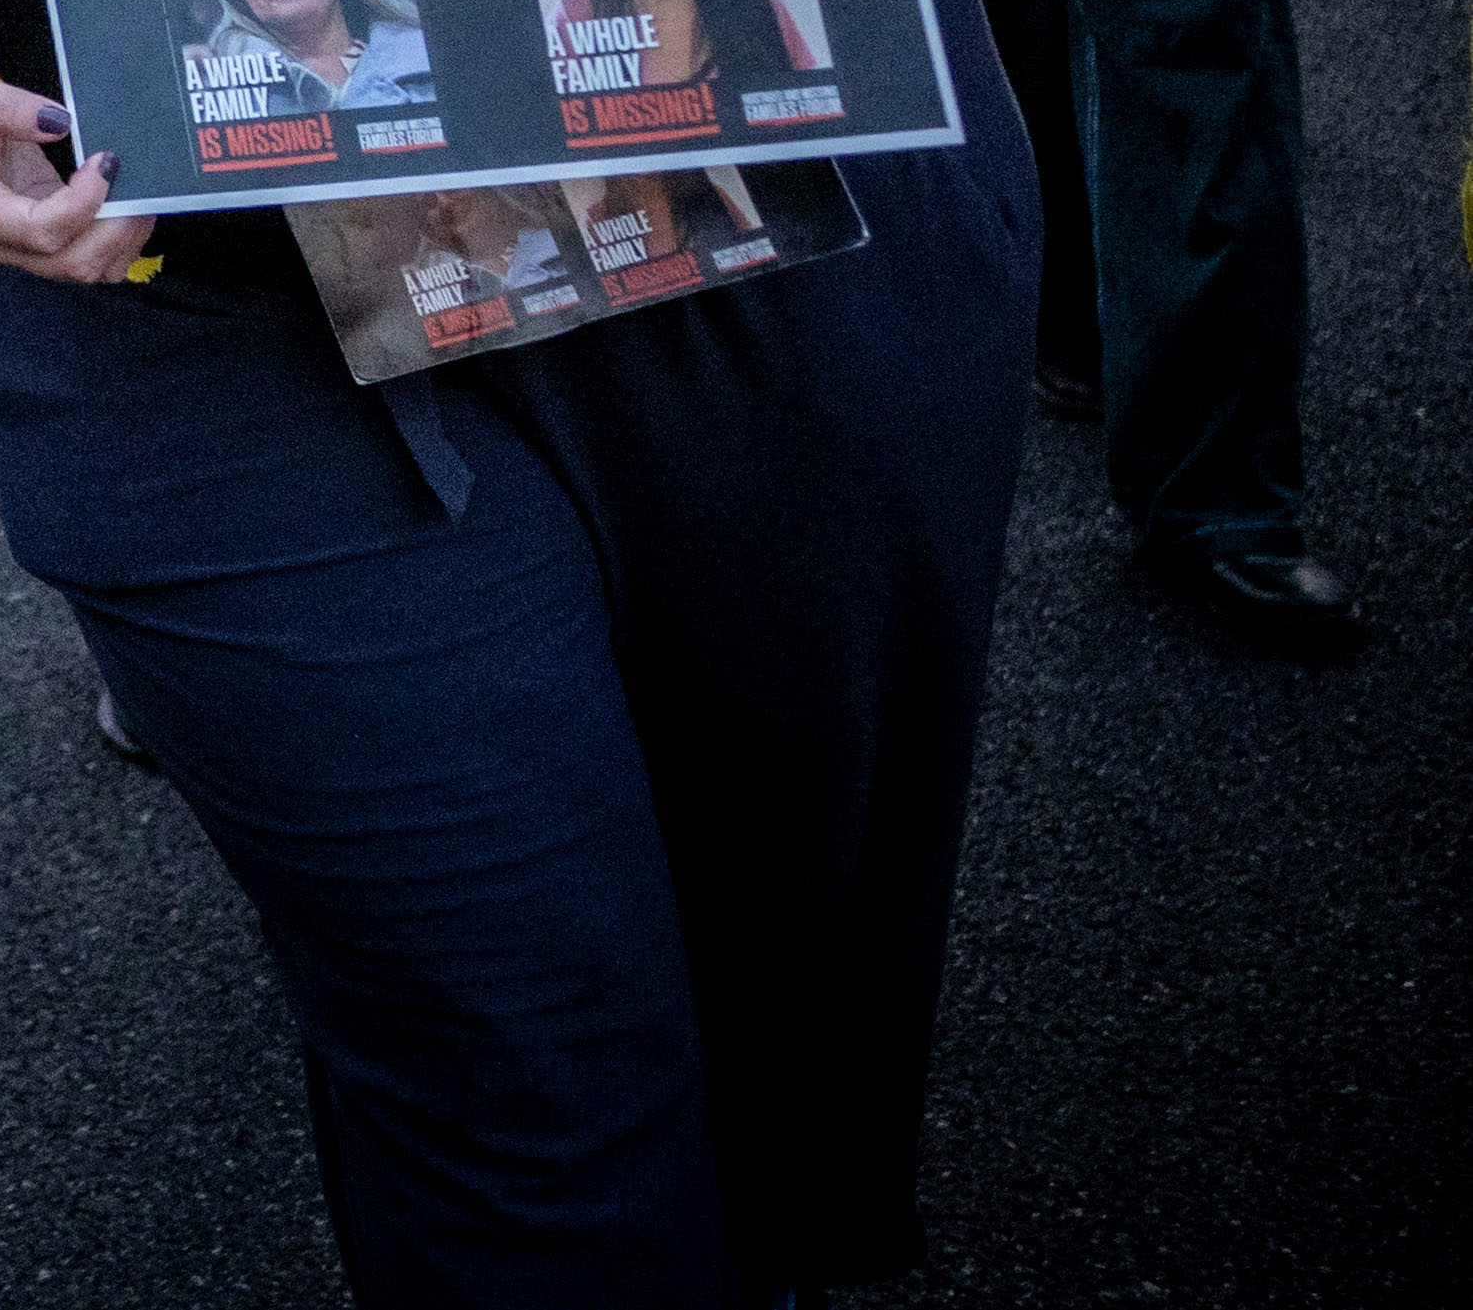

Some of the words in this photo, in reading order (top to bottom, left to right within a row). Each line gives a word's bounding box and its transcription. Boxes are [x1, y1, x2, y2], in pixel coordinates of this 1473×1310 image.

[566, 13, 661, 55] WHOLE
[206, 51, 287, 87] WHOLE
[550, 51, 642, 95] FAMILY
[189, 86, 269, 124] FAMILY
[559, 98, 590, 134] IS
[591, 82, 717, 132] MISSING!
[197, 128, 223, 160] IS
[225, 112, 335, 158] MISSING!
[587, 237, 650, 274] FAMILY
